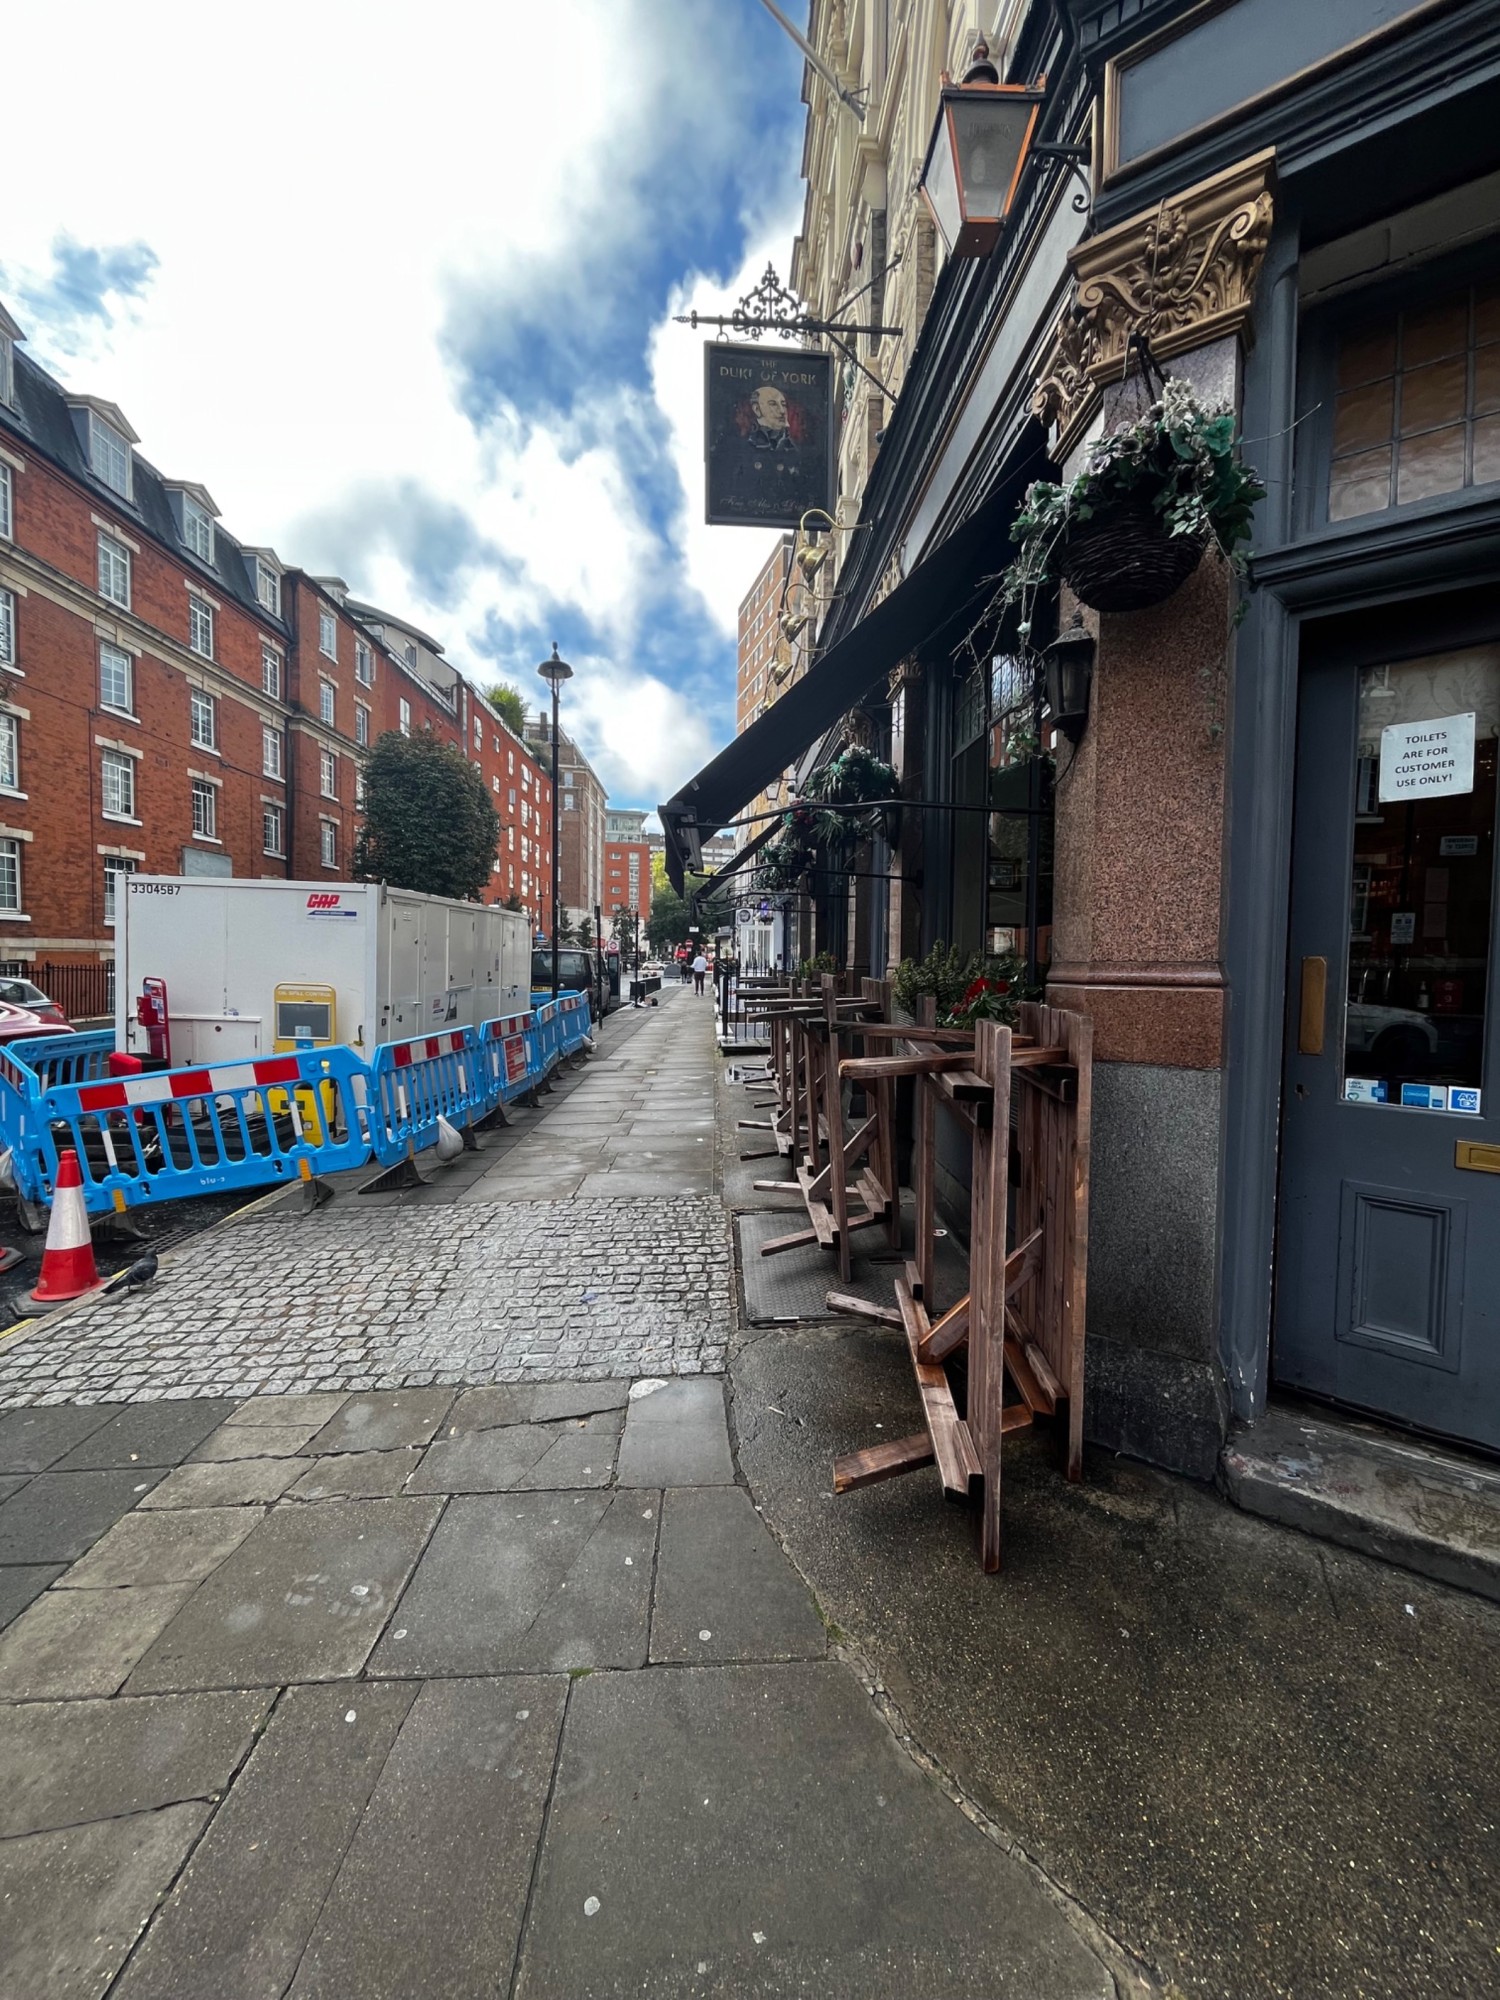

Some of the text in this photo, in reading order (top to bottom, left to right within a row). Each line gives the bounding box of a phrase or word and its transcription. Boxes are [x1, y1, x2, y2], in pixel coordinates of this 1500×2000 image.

[762, 360, 777, 369] THE
[760, 370, 778, 382] OF
[781, 371, 817, 385] YORK
[1405, 731, 1447, 744] TOILETS
[1402, 746, 1448, 760] ARE FOR
[1395, 759, 1455, 774] CUSTOMER
[1396, 773, 1452, 788] USE ONLY!
[131, 883, 181, 896] 3304587
[1457, 1092, 1477, 1101] AM
[1460, 1100, 1477, 1109] EX
